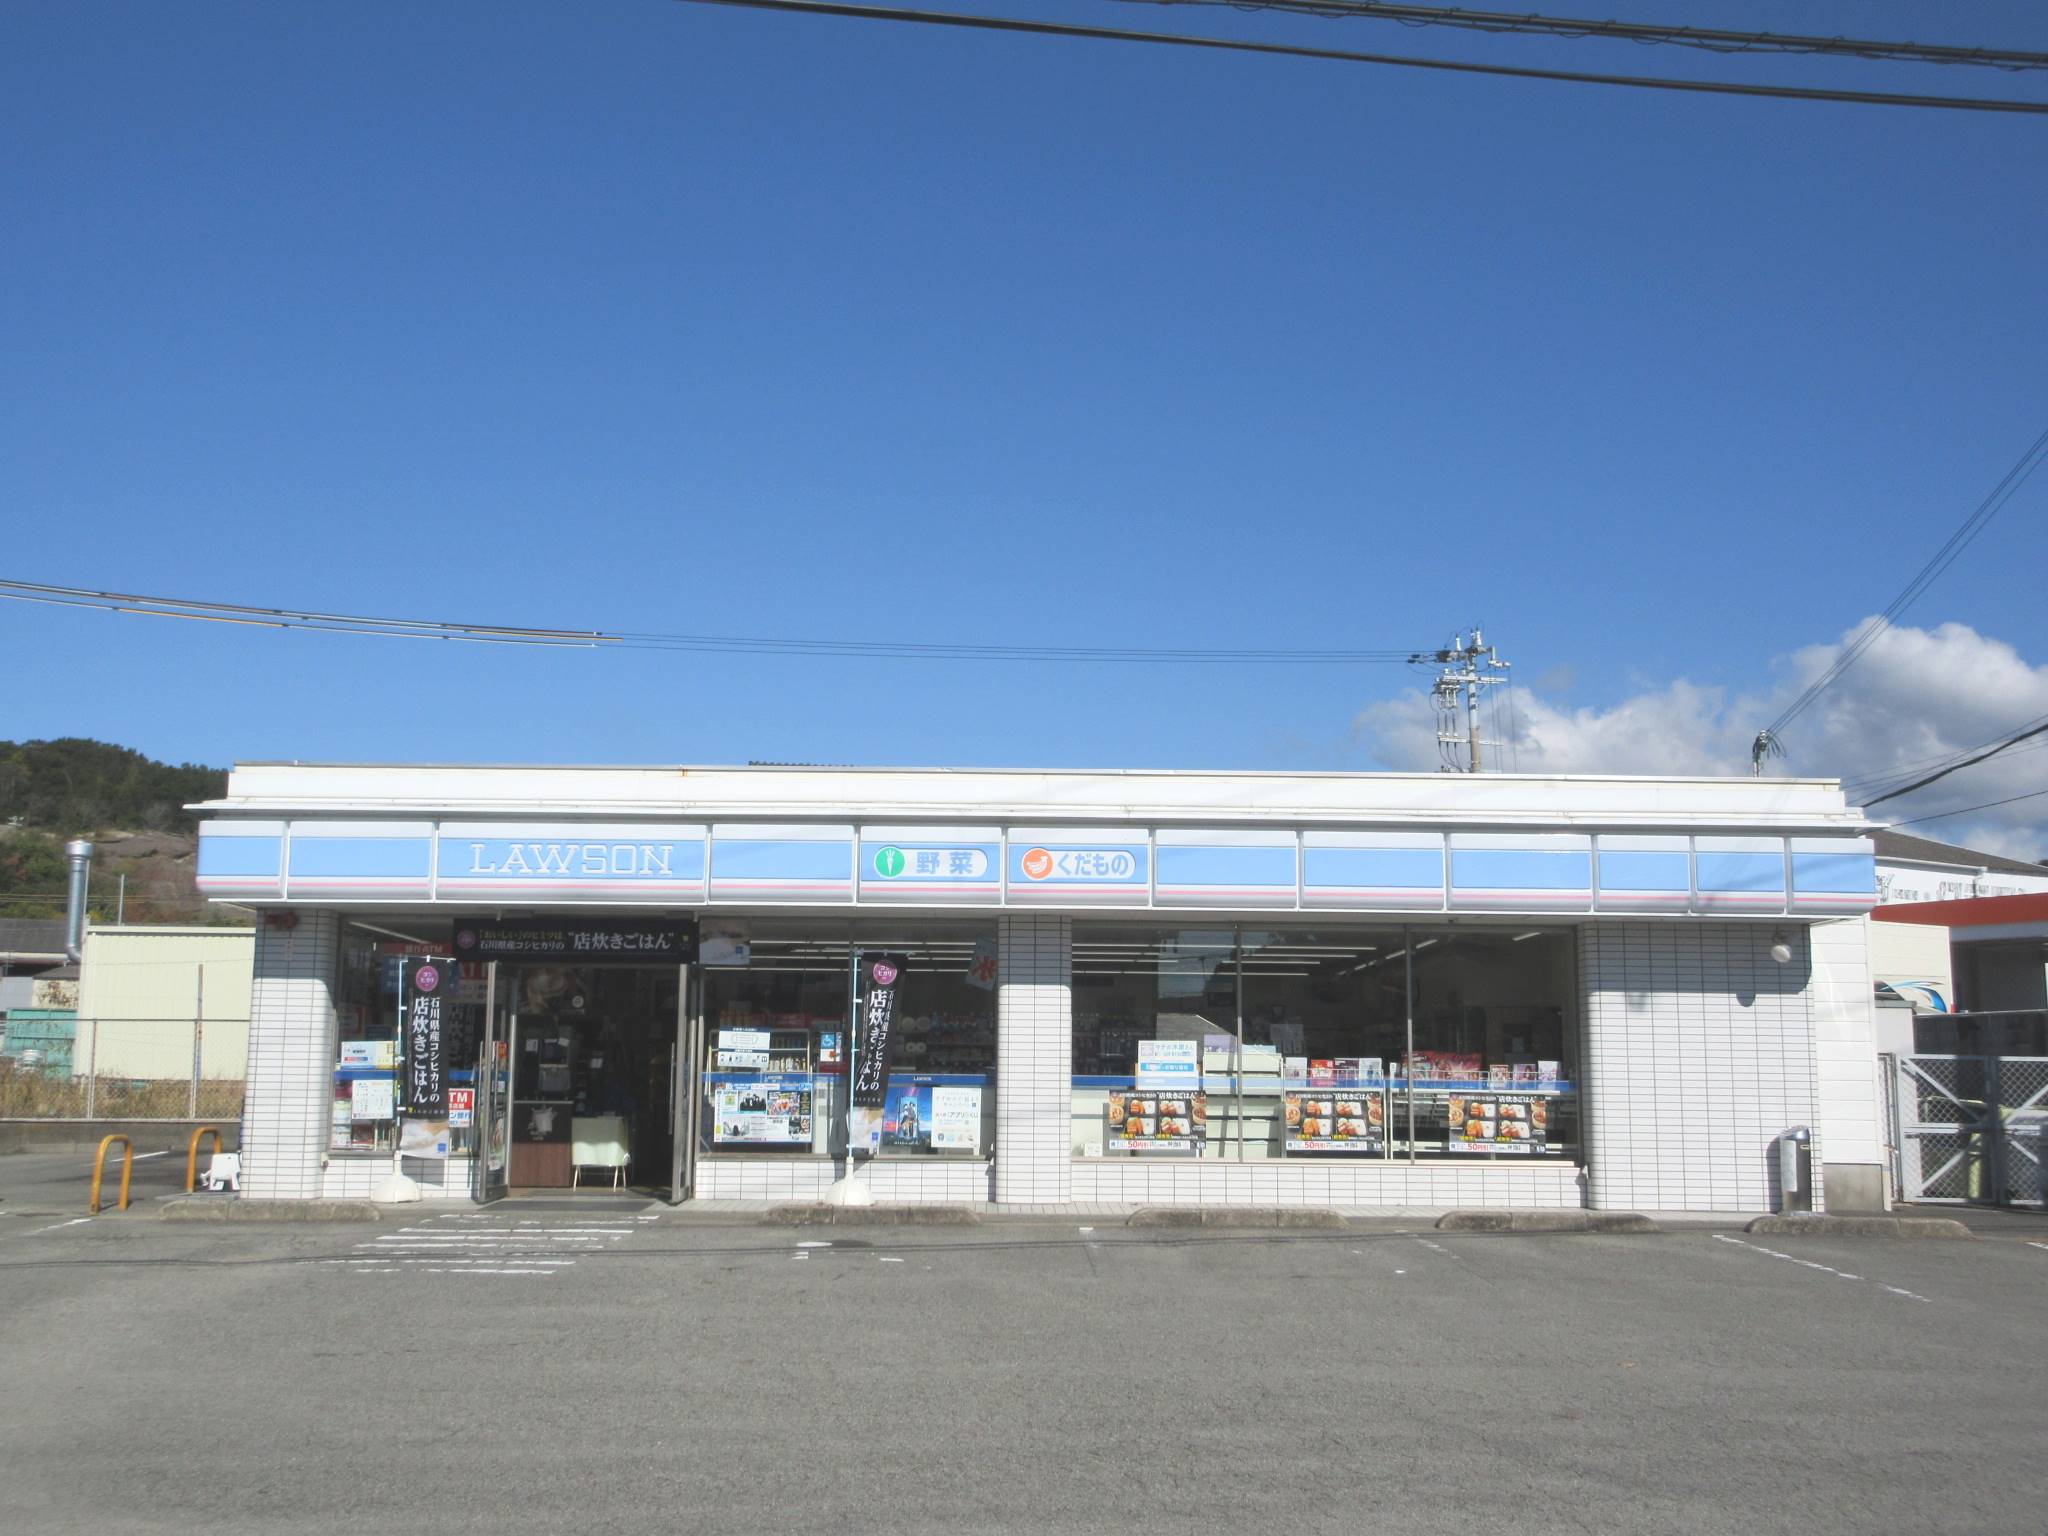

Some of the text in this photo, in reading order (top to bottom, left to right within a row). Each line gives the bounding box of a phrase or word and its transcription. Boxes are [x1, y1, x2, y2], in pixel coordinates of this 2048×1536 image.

[469, 843, 674, 877] LAWSON
[916, 851, 974, 876] 野菜
[1058, 852, 1129, 877] くだもの
[480, 940, 565, 950] 石川県産コシヒカリの
[412, 996, 429, 1104] 店炊きごはん
[430, 997, 440, 1103] 石川県産コシヒカリの
